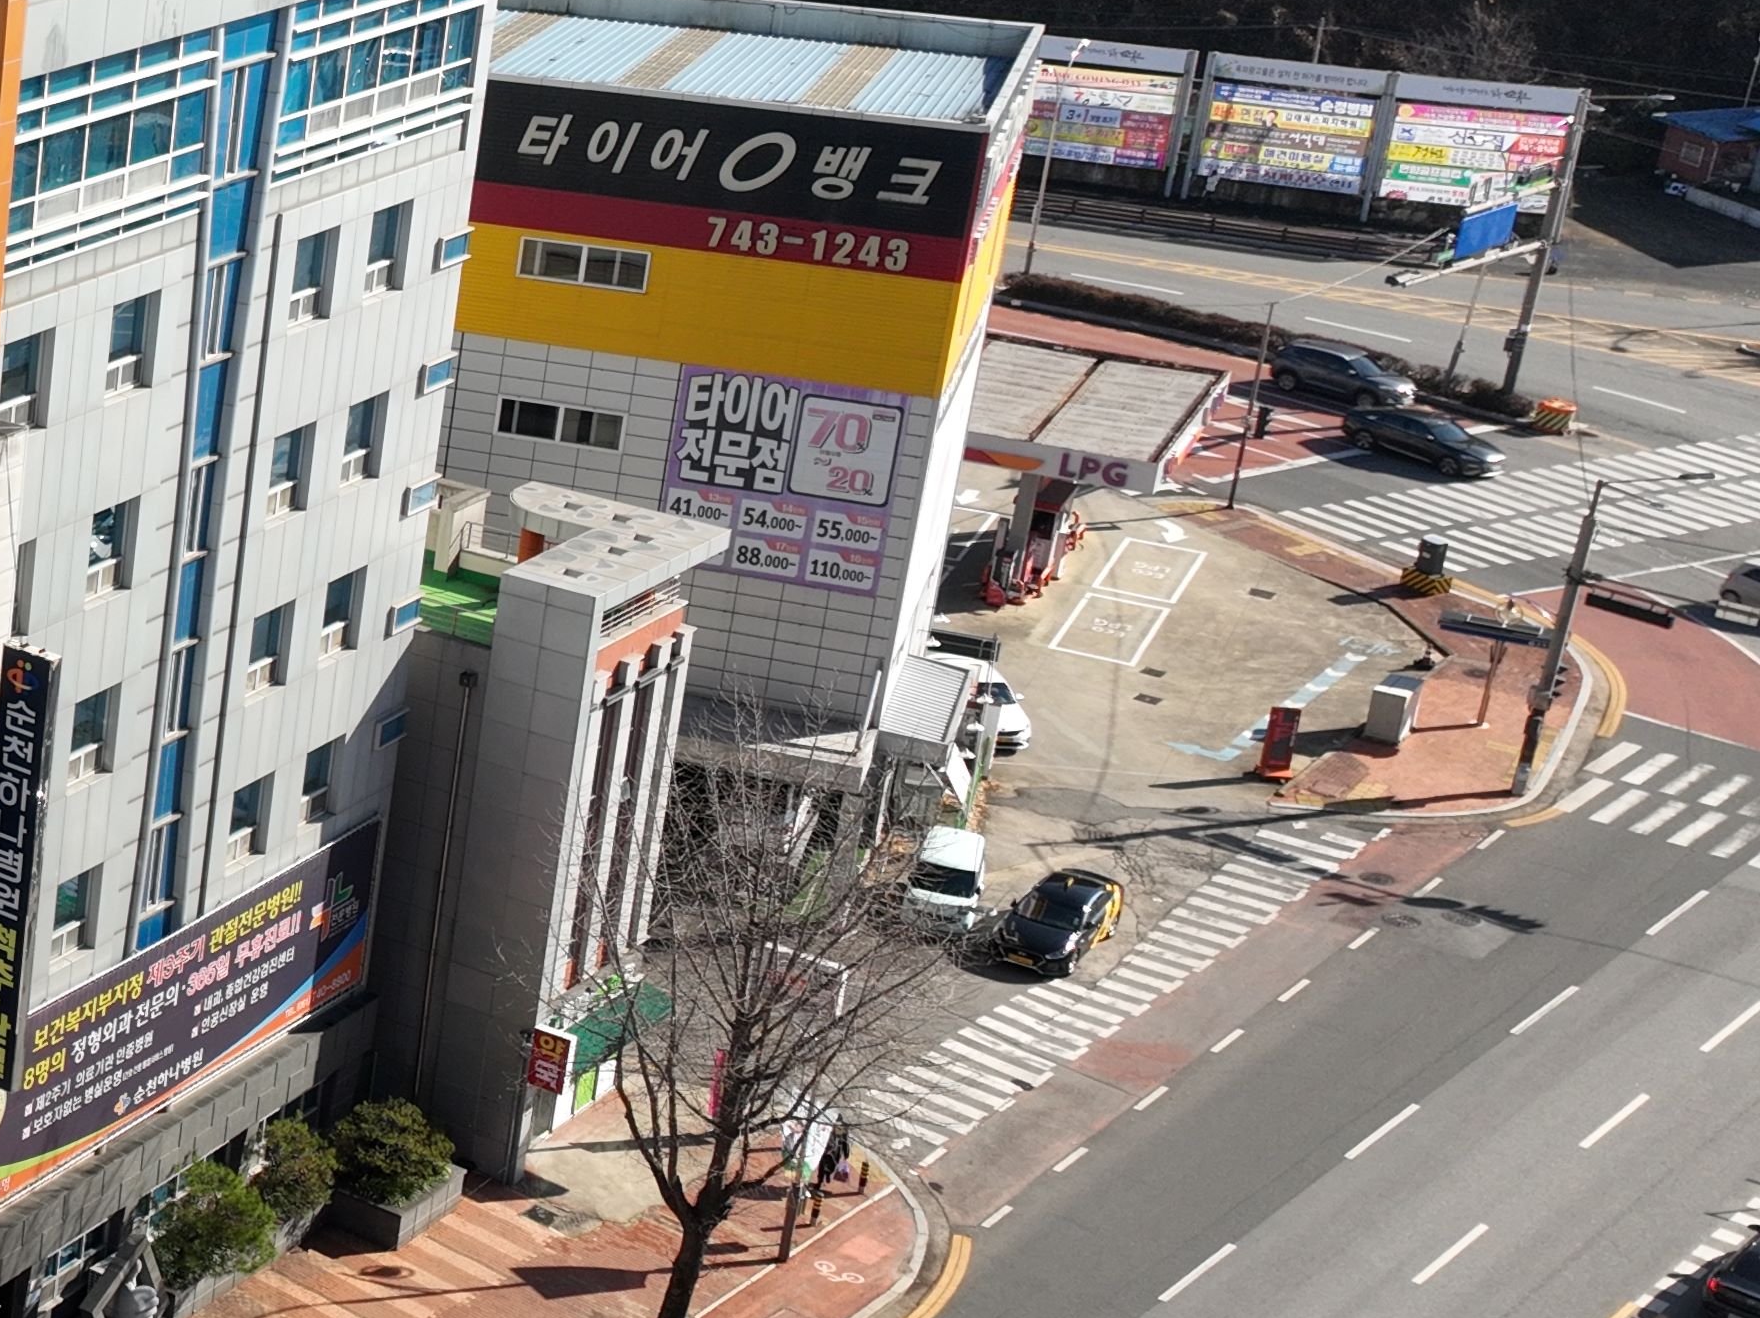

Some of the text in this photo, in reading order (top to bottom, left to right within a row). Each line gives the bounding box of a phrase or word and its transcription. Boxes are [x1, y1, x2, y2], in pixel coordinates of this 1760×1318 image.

[706, 216, 909, 273] 743-1243
[684, 373, 800, 442] 타이어
[676, 426, 786, 496] 전문점
[1059, 452, 1129, 488] LPG
[742, 507, 802, 531] 54,000~
[816, 519, 878, 544] 55,000~
[736, 545, 797, 570] 88,000~
[809, 559, 872, 584] 110,000~
[32, 970, 144, 1053] 보건복지부지정
[146, 934, 206, 988] 제3주기
[201, 981, 269, 1033] 인공신장실 운영
[23, 1047, 66, 1091] 8명의
[71, 1009, 132, 1064] 정형외과
[134, 981, 180, 1028] 전문의
[533, 1035, 567, 1090] 약국
[35, 1077, 71, 1112] 제2주기
[75, 1053, 114, 1089] 의료기관
[115, 1029, 154, 1065] 인증병원
[133, 1047, 204, 1104] 순천하나병원
[32, 1069, 123, 1134] 보호자없는 병실운영
